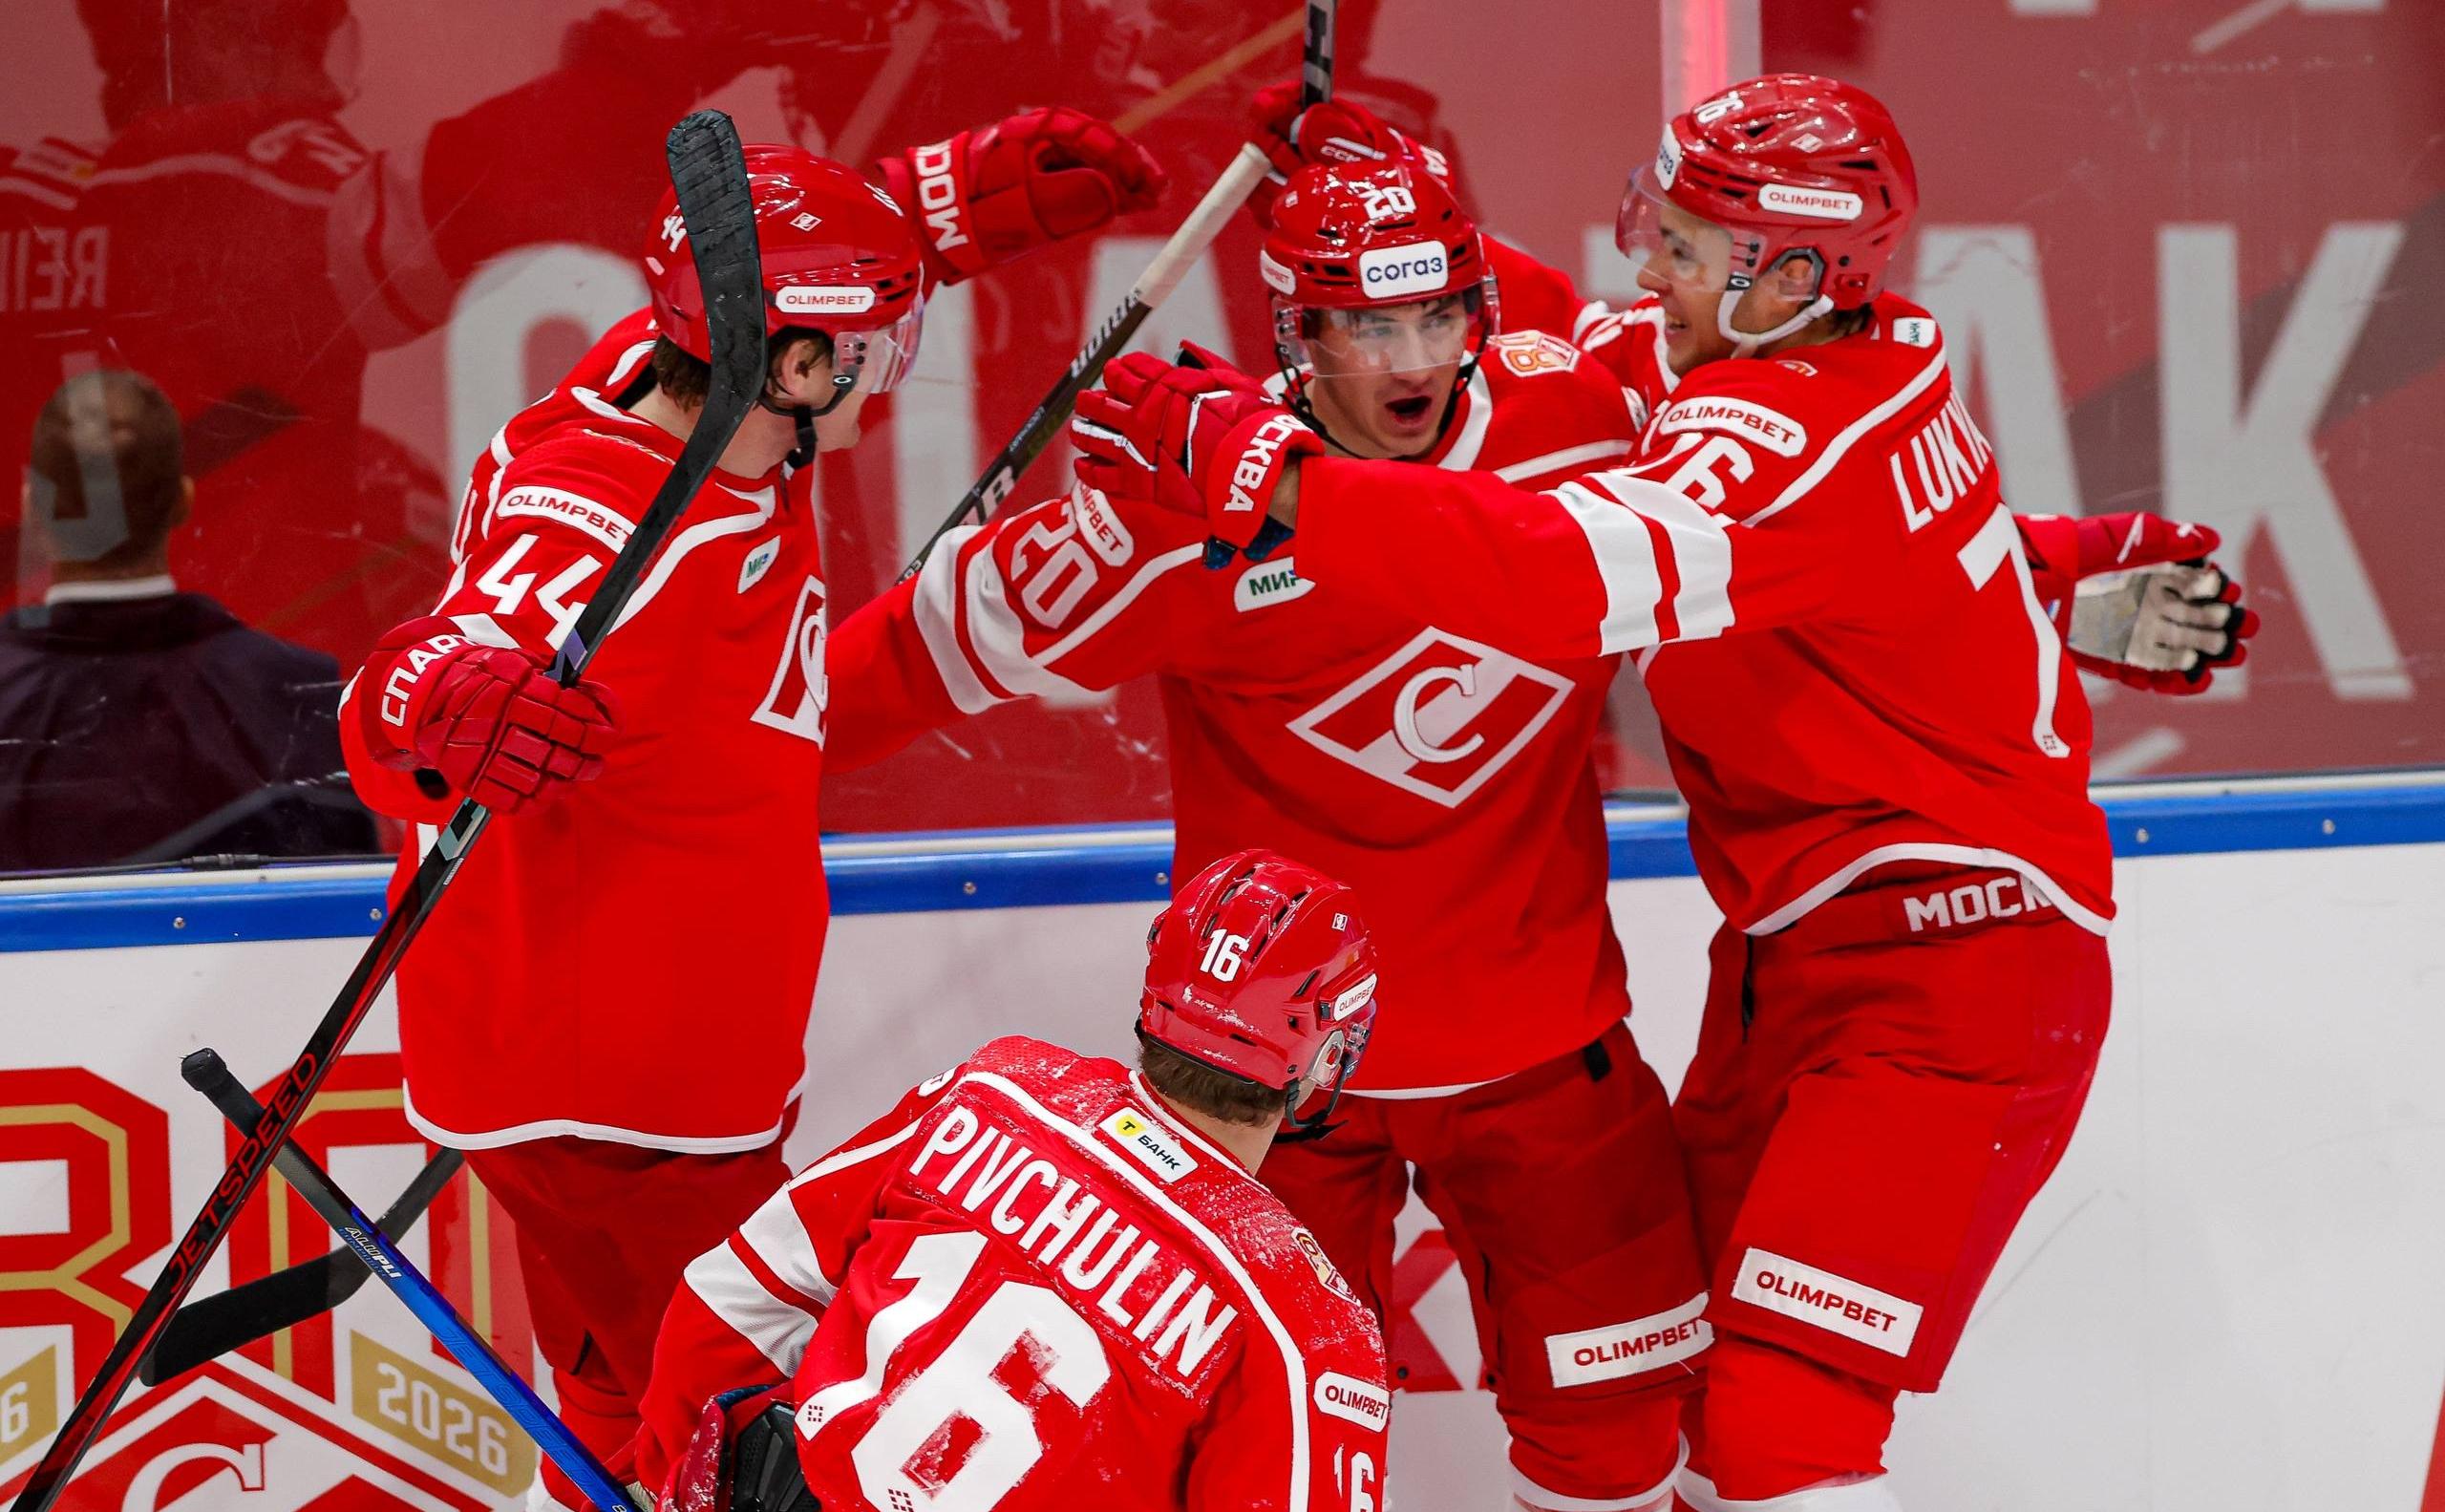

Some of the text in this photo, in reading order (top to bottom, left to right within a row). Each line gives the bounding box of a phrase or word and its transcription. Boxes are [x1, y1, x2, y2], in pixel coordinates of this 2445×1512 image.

[1358, 186, 1416, 220] 20
[1769, 192, 1853, 210] OLIMPBET
[1367, 256, 1443, 284] согаз
[786, 293, 867, 306] OLIMPBET
[1668, 405, 1797, 445] OLIMPBET
[1010, 500, 1099, 630] 20
[476, 533, 604, 652] 44
[1200, 928, 1249, 982] 16
[1338, 983, 1374, 1012] OLIMPBET
[168, 1053, 318, 1294] JETSPEED
[1137, 1134, 1181, 1171] БАНК
[908, 1104, 1240, 1378] PIVCHULIN
[1756, 1270, 1898, 1332] OLIMPBET
[1574, 1319, 1700, 1366] OLIMPBET
[795, 1230, 1112, 1512] 16
[378, 1362, 508, 1477] 2026
[1325, 1384, 1388, 1420] OLIMPBET
